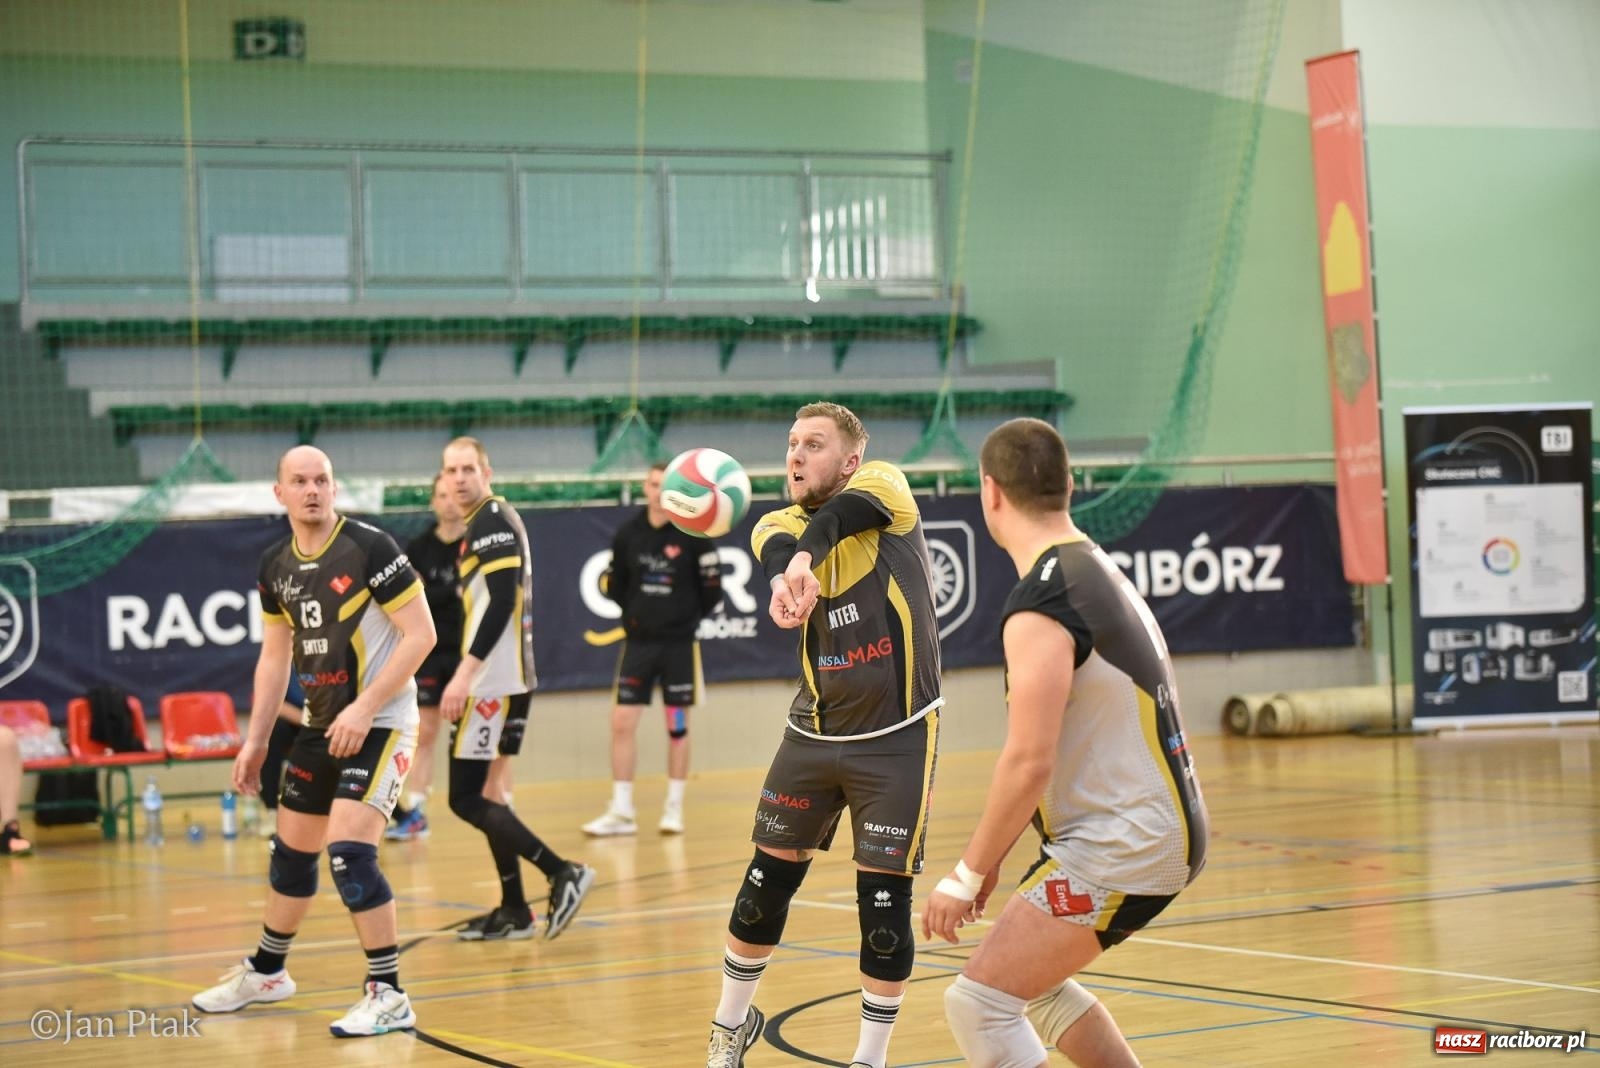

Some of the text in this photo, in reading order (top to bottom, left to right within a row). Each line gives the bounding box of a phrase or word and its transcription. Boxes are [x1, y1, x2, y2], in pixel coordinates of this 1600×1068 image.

[301, 600, 323, 629] 13
[828, 603, 860, 630] NTER
[478, 726, 491, 748] 3
[864, 822, 908, 836] GRAVTON
